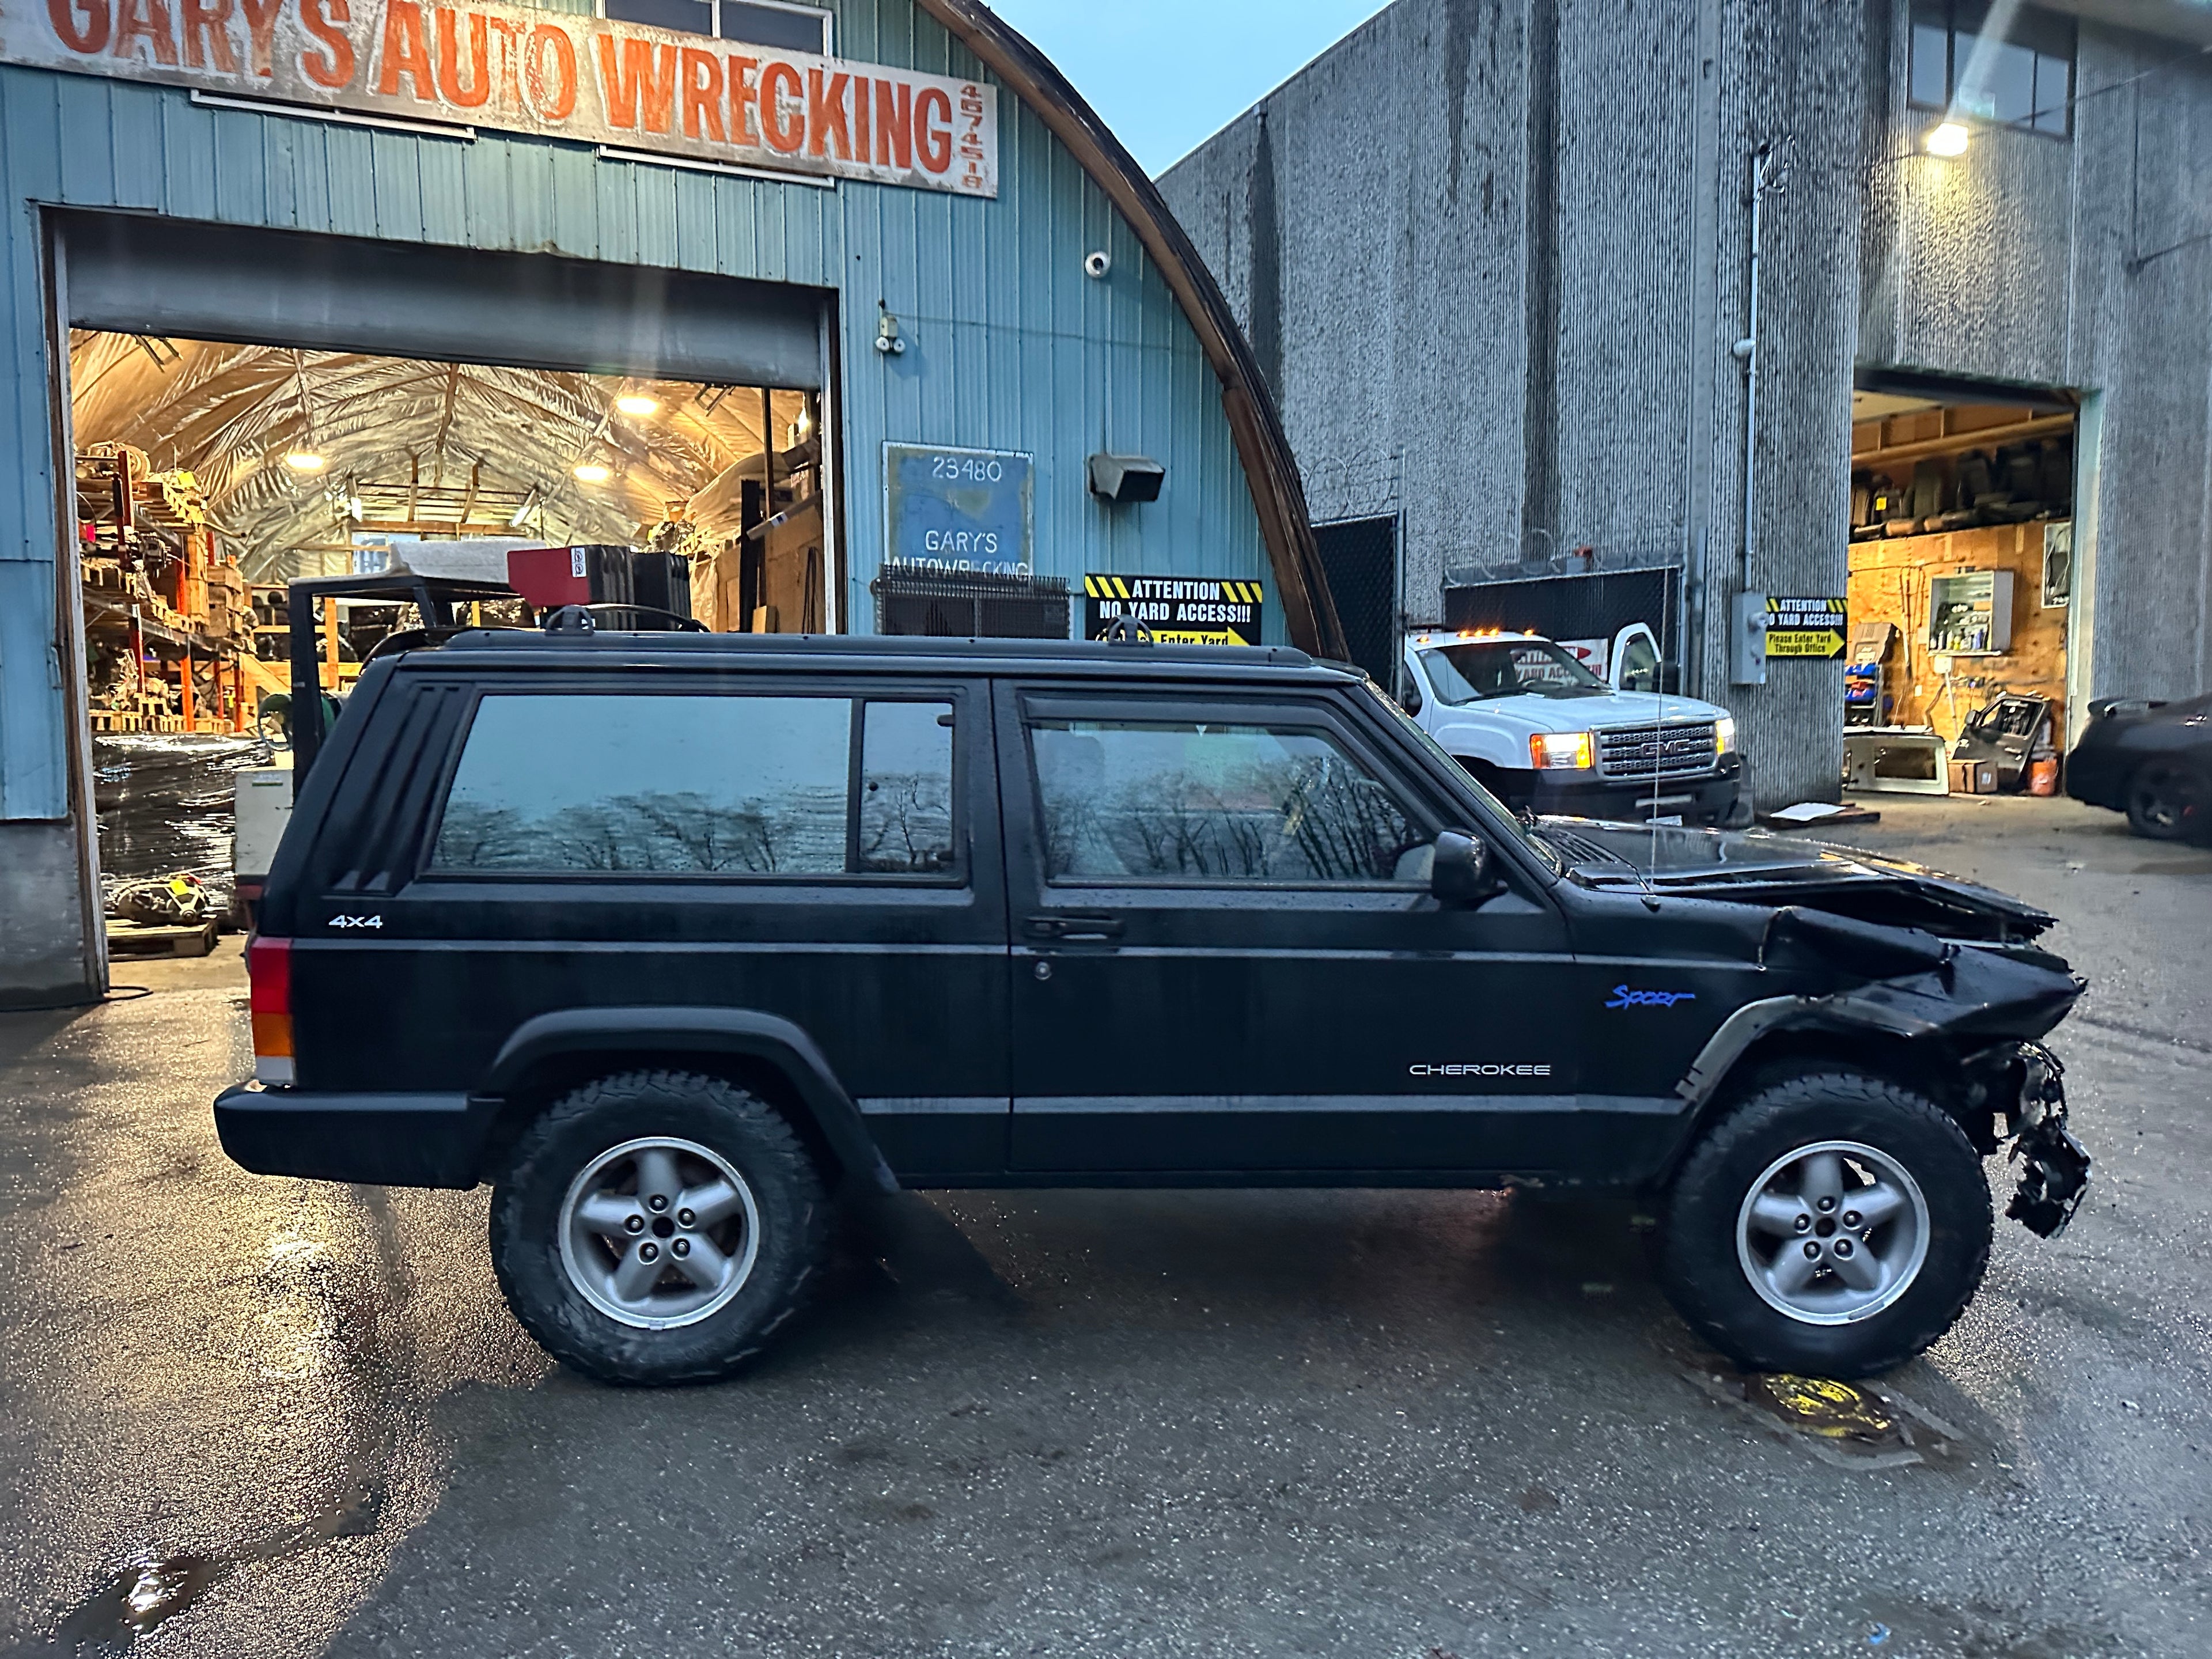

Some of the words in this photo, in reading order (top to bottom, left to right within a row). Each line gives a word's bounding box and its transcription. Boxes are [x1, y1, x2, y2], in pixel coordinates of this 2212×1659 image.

[378, 0, 577, 120] AUTO
[597, 34, 952, 174] WRECKING
[932, 456, 1002, 483] 23480
[925, 530, 998, 554] GARY'S
[1132, 579, 1219, 600] ATTENTION
[1100, 601, 1121, 619] NO
[1128, 602, 1170, 620] YARD
[1176, 604, 1251, 623] ACCESS!!!
[1779, 599, 1827, 612] ATTENTION
[1778, 613, 1801, 626] YARD
[1802, 613, 1843, 626] ACCESS!!!
[1769, 634, 1792, 643] Please
[1794, 634, 1813, 643] Enter
[1816, 634, 1831, 643] Yard
[1775, 644, 1802, 654] Through
[1805, 644, 1825, 653] Office
[1641, 739, 1690, 757] GMC
[1409, 1065, 1551, 1075] CHEROKEE
